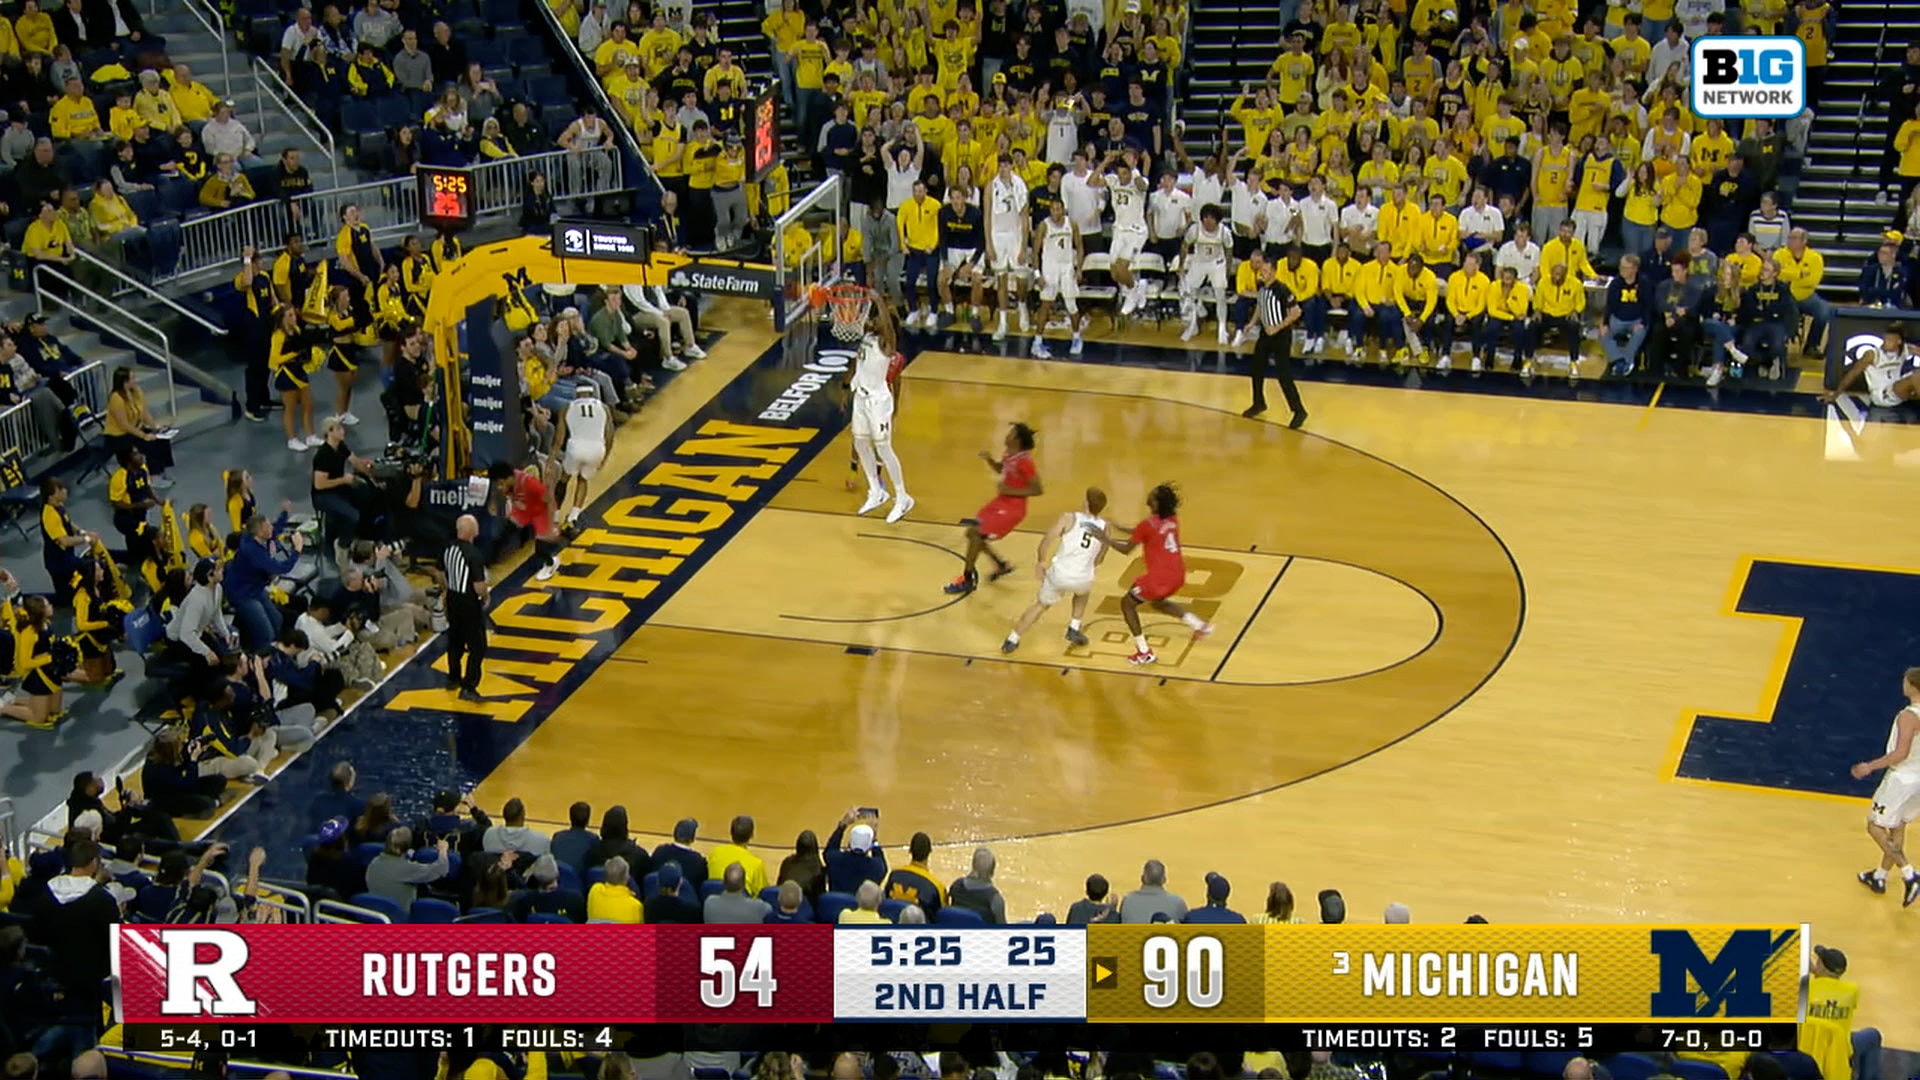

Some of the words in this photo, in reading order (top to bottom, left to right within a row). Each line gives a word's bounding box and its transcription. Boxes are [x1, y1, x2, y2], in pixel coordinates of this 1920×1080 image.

[1805, 27, 1814, 39] 2
[433, 175, 467, 193] 5:25
[502, 266, 532, 293] M
[1621, 289, 1637, 303] M
[472, 375, 501, 387] meijer
[474, 396, 503, 409] meijer
[758, 372, 833, 421] BELFOR
[580, 404, 594, 418] 11
[474, 419, 504, 434] meijer
[430, 485, 485, 511] meij
[1080, 531, 1093, 549] 5
[1164, 532, 1179, 553] 4
[384, 419, 820, 723] MICHIGAN
[1872, 802, 1886, 815] M
